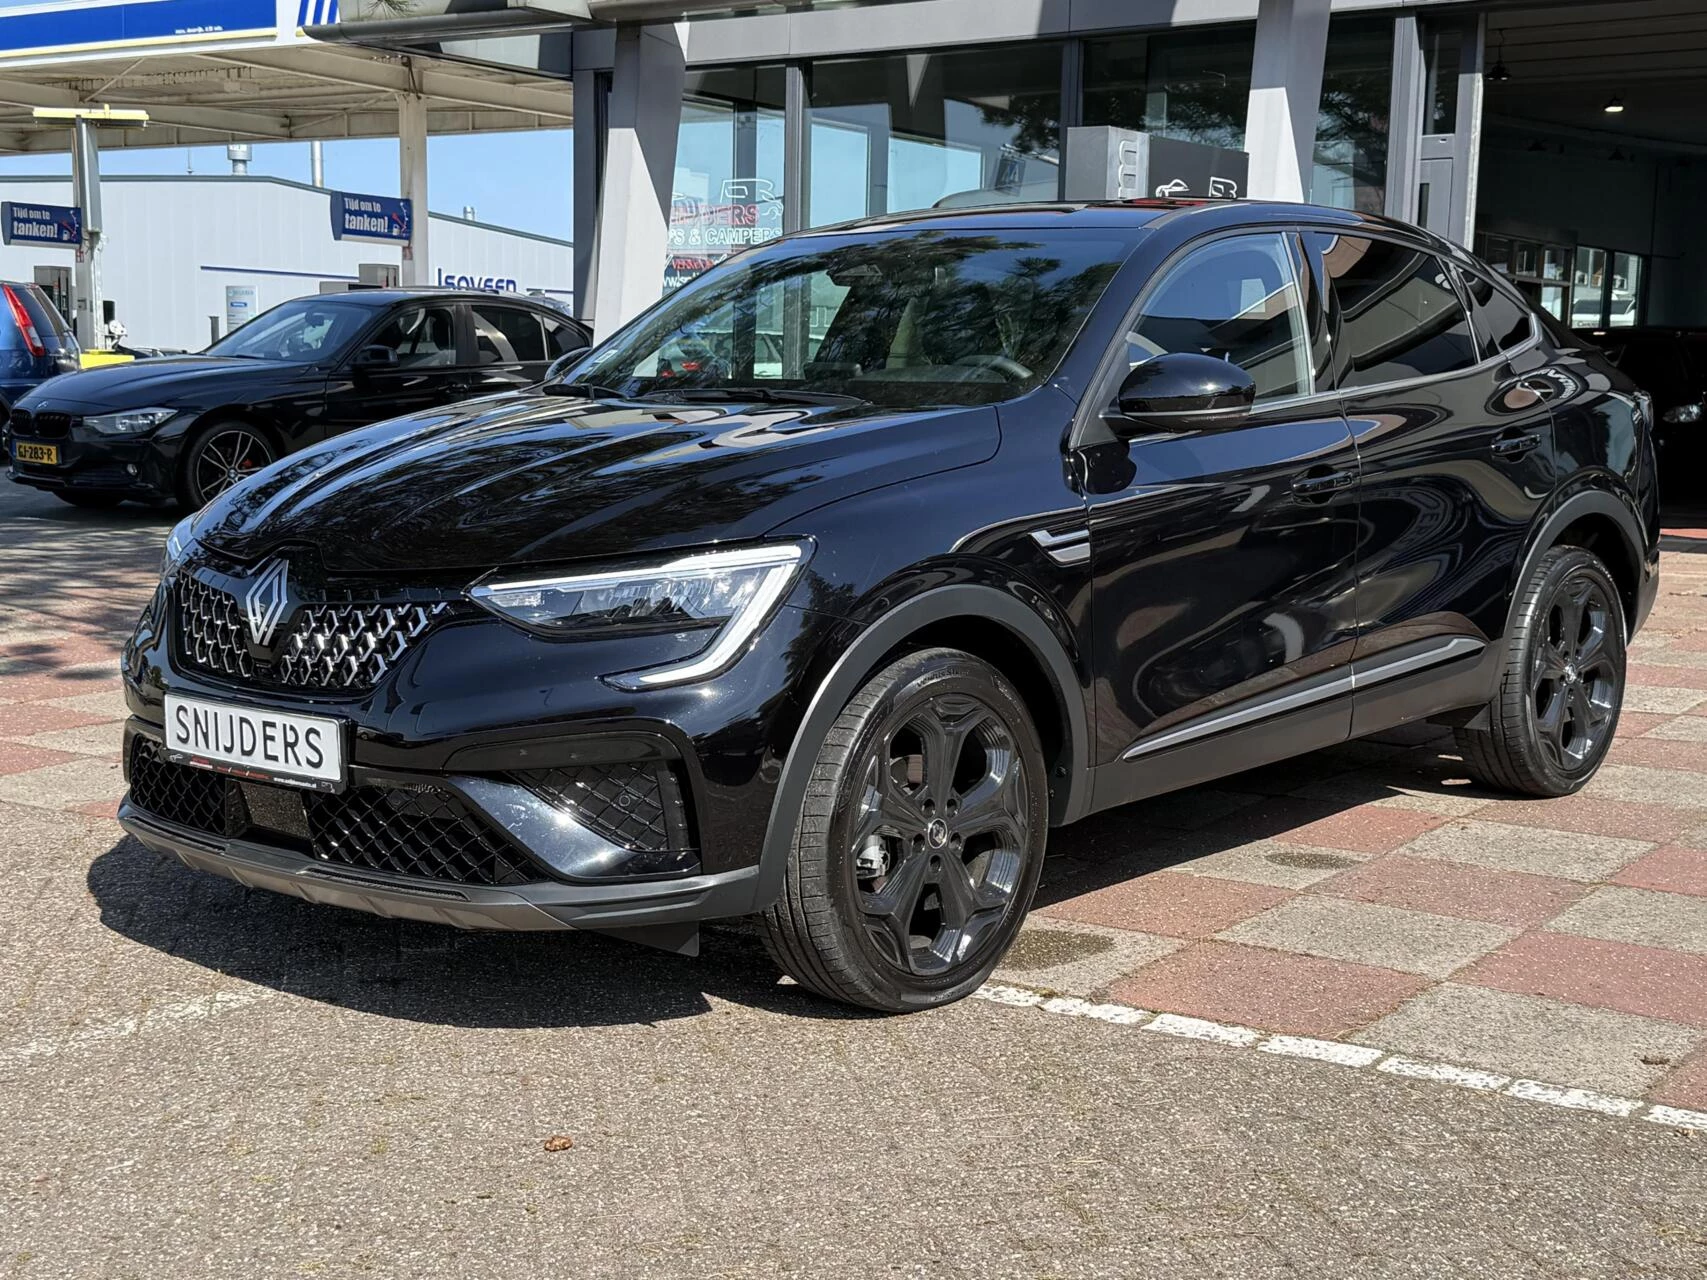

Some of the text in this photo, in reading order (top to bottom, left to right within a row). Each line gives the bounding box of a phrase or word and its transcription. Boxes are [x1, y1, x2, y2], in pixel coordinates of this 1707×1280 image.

[13, 206, 51, 220] Tijd om te
[344, 198, 382, 213] Tijd om te
[13, 220, 58, 238] tanken!
[344, 213, 389, 233] tanken!
[688, 228, 702, 246] &
[17, 444, 54, 462] GJ-283-R
[175, 704, 324, 769] SNIJDERS
